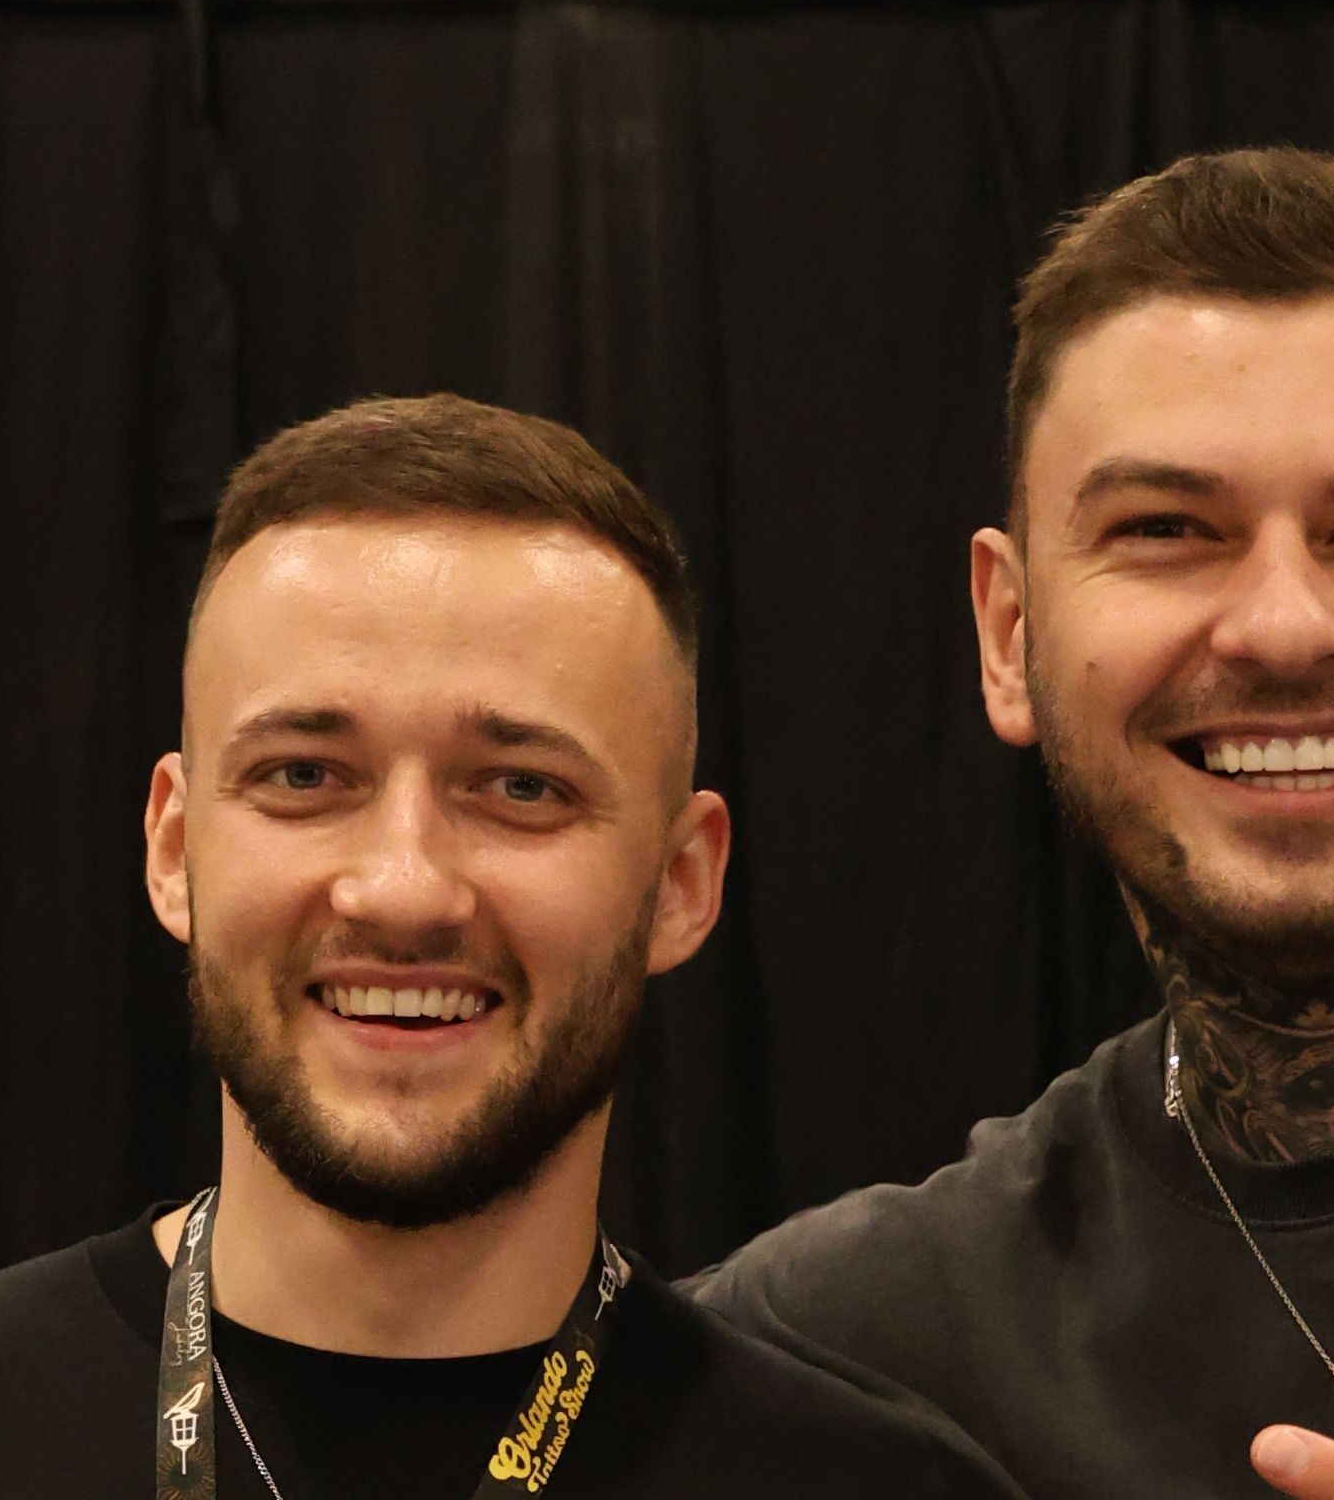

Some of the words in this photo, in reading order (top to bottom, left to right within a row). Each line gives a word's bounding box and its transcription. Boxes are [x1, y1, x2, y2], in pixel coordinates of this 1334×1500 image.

[187, 1271, 208, 1362] ANGORA
[489, 1350, 568, 1481] Orlando
[527, 1411, 571, 1493] Tattoo
[559, 1349, 596, 1420] Show
